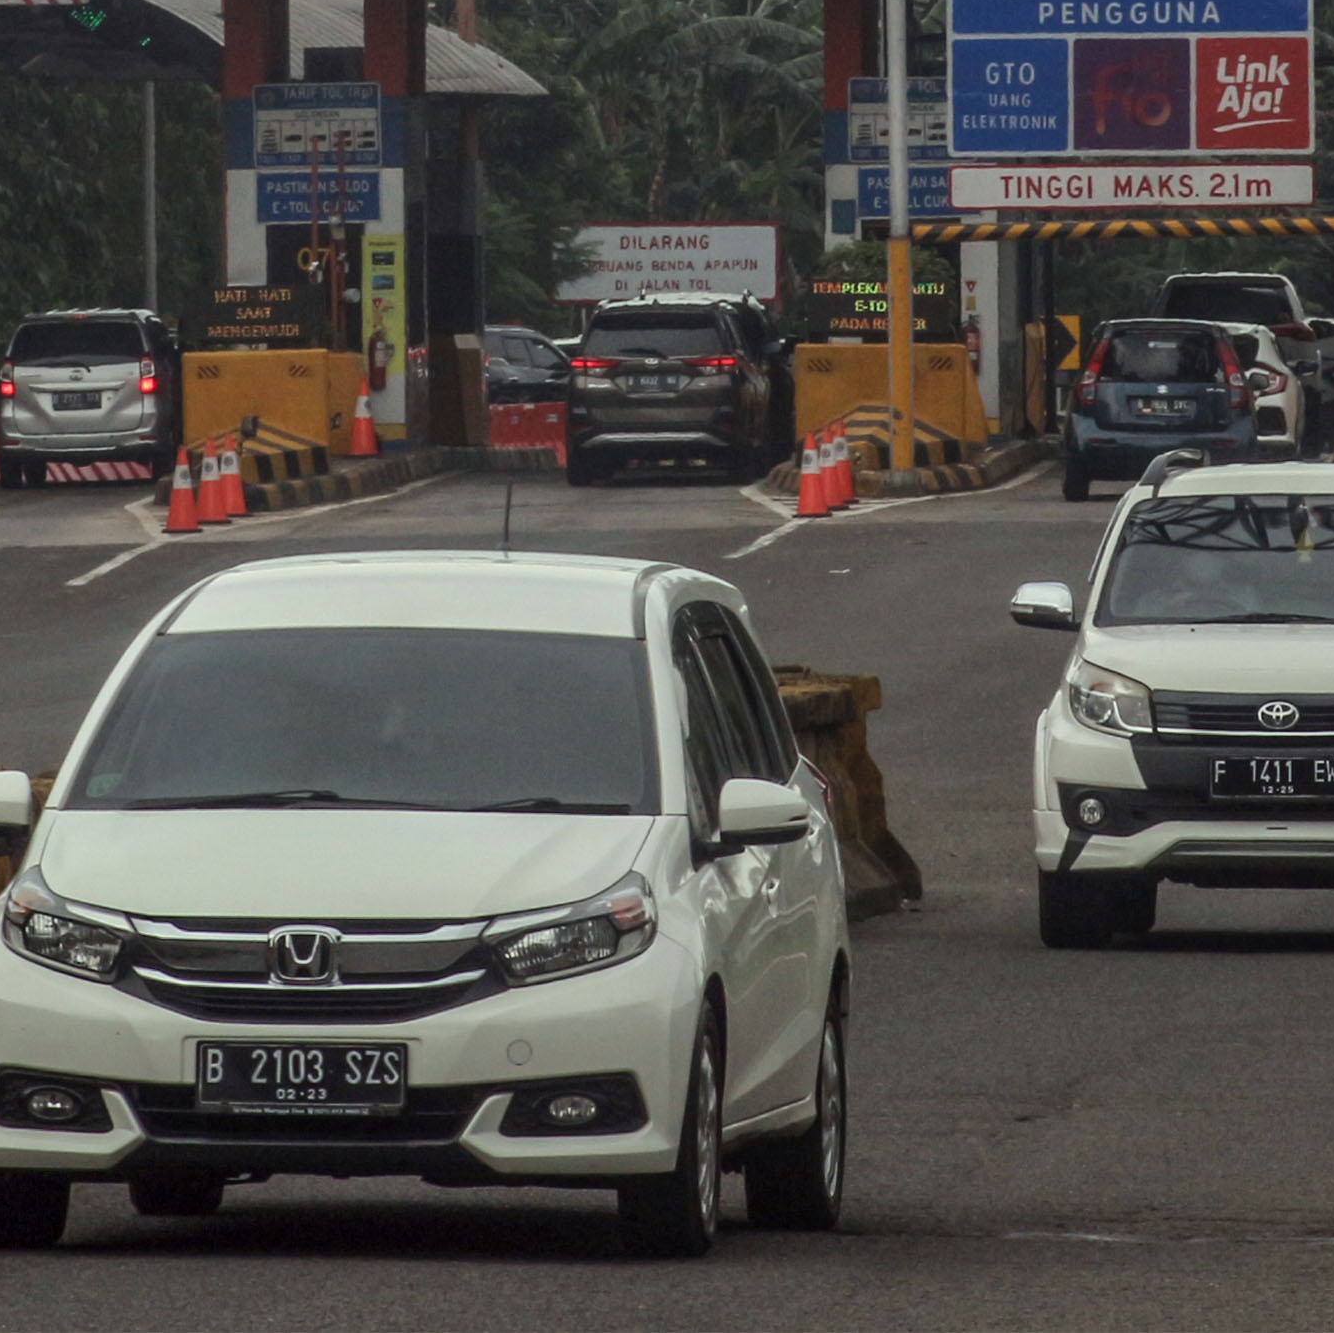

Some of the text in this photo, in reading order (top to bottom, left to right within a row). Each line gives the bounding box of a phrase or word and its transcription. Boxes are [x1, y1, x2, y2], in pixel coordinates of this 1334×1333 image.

[1039, 1, 1220, 25] PENGGUNA
[985, 62, 1035, 86] GTO
[1216, 54, 1290, 86] Link
[988, 93, 1031, 108] UANG
[1217, 85, 1283, 119] Aja!
[962, 115, 1057, 130] ELEKTRONIK
[268, 180, 370, 193] PASTIKN SLDO
[867, 177, 927, 189] PASAN
[1000, 175, 1093, 200] TINGGI
[1114, 174, 1200, 198] MAKS.
[619, 235, 710, 251] DILARANG
[651, 259, 695, 272] BENDA
[703, 258, 759, 272] APAPUN
[614, 278, 712, 292] DI JALAN TOL
[813, 282, 888, 295] TEMPLEKA
[236, 307, 272, 320] SAAT
[830, 317, 869, 330] PADA
[1214, 760, 1226, 783] F
[1250, 760, 1292, 783] 1411
[206, 1048, 400, 1085] B 2103 SZS
